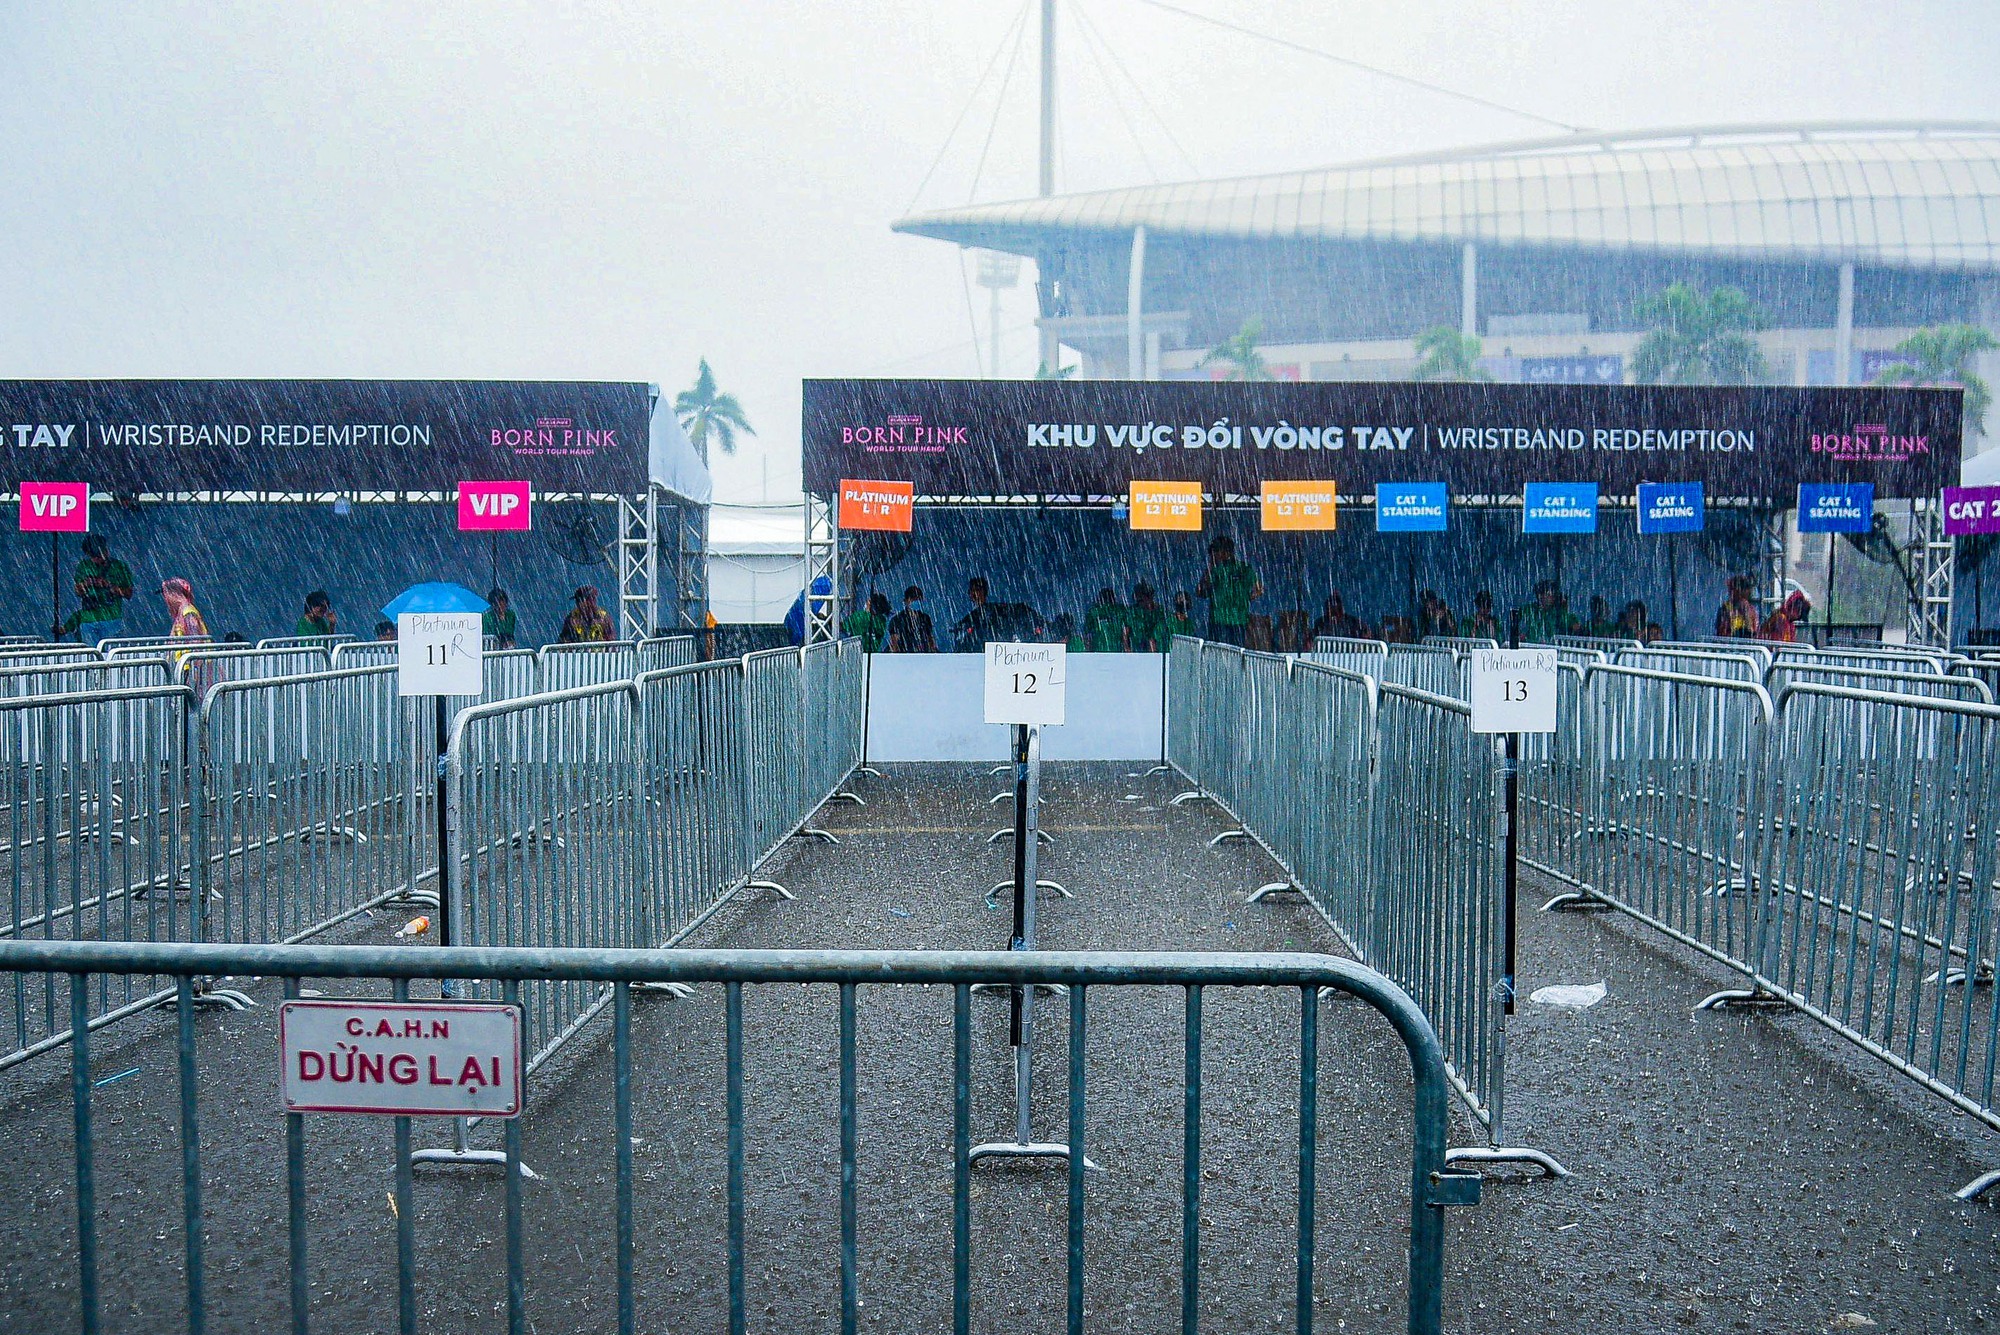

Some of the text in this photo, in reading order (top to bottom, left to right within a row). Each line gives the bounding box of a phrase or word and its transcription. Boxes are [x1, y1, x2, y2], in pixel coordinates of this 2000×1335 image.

[12, 424, 76, 448] TAY
[99, 424, 251, 447] WRISTBAND
[260, 424, 430, 446] REDEMPTION
[491, 429, 617, 447] BORN PINK
[842, 426, 968, 444] BORN PINK
[1027, 417, 1754, 455] KHU VỰC ĐỔI VÒNG TAY WRISTBAND REDEMPTION
[866, 445, 894, 453] WORLD
[1811, 434, 1930, 453] BORN PINK
[546, 448, 567, 456] TOUR
[30, 493, 77, 517] VIP
[468, 493, 520, 516] VIP
[845, 490, 909, 505] PLATINUM
[1135, 493, 1198, 505] PLATINUM
[1266, 493, 1332, 505] PLATINUM
[1396, 495, 1416, 505] CAT
[1543, 496, 1565, 506] CAT
[1656, 496, 1676, 507] CAT
[1818, 496, 1840, 506] CAT
[862, 504, 890, 515] L R
[1146, 504, 1188, 515] L2 R2
[1277, 505, 1320, 515] L2 R2
[1382, 506, 1442, 517] STANDING
[1529, 507, 1592, 518] STANDING
[1649, 506, 1694, 519] SEATING
[1809, 507, 1861, 519] SEATING
[1948, 500, 1986, 520] CAT
[426, 644, 449, 666] 11
[993, 643, 1056, 666] Platinum
[1480, 650, 1536, 673] Platinum
[1012, 672, 1037, 694] 12
[1503, 680, 1528, 702] 13
[346, 1017, 450, 1038] C.A.H.N
[299, 1041, 501, 1094] DỪNG LẠI
